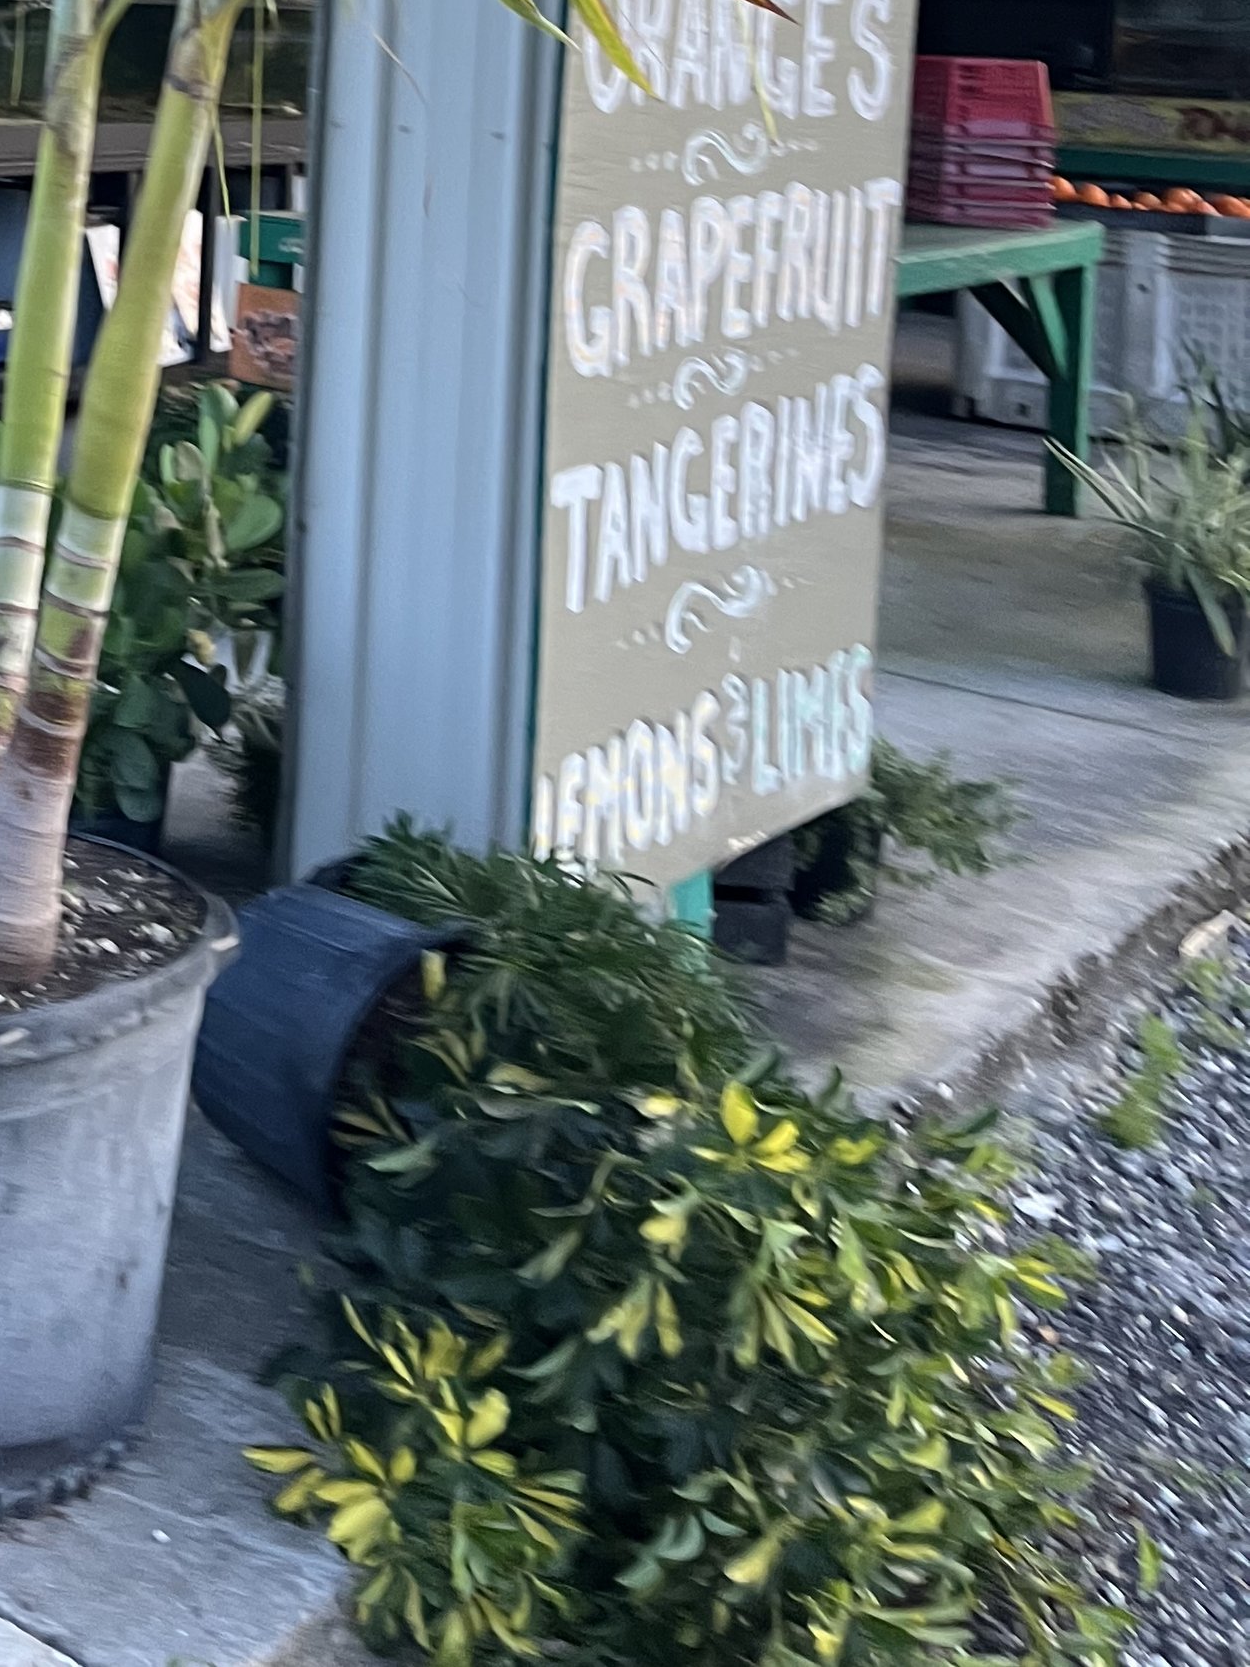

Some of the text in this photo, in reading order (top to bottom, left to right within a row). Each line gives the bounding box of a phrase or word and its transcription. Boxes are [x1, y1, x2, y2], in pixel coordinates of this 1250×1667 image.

[564, 176, 903, 377] GRAPEFRUIT
[551, 362, 885, 614] TANGERINES
[750, 642, 874, 797] LIMES
